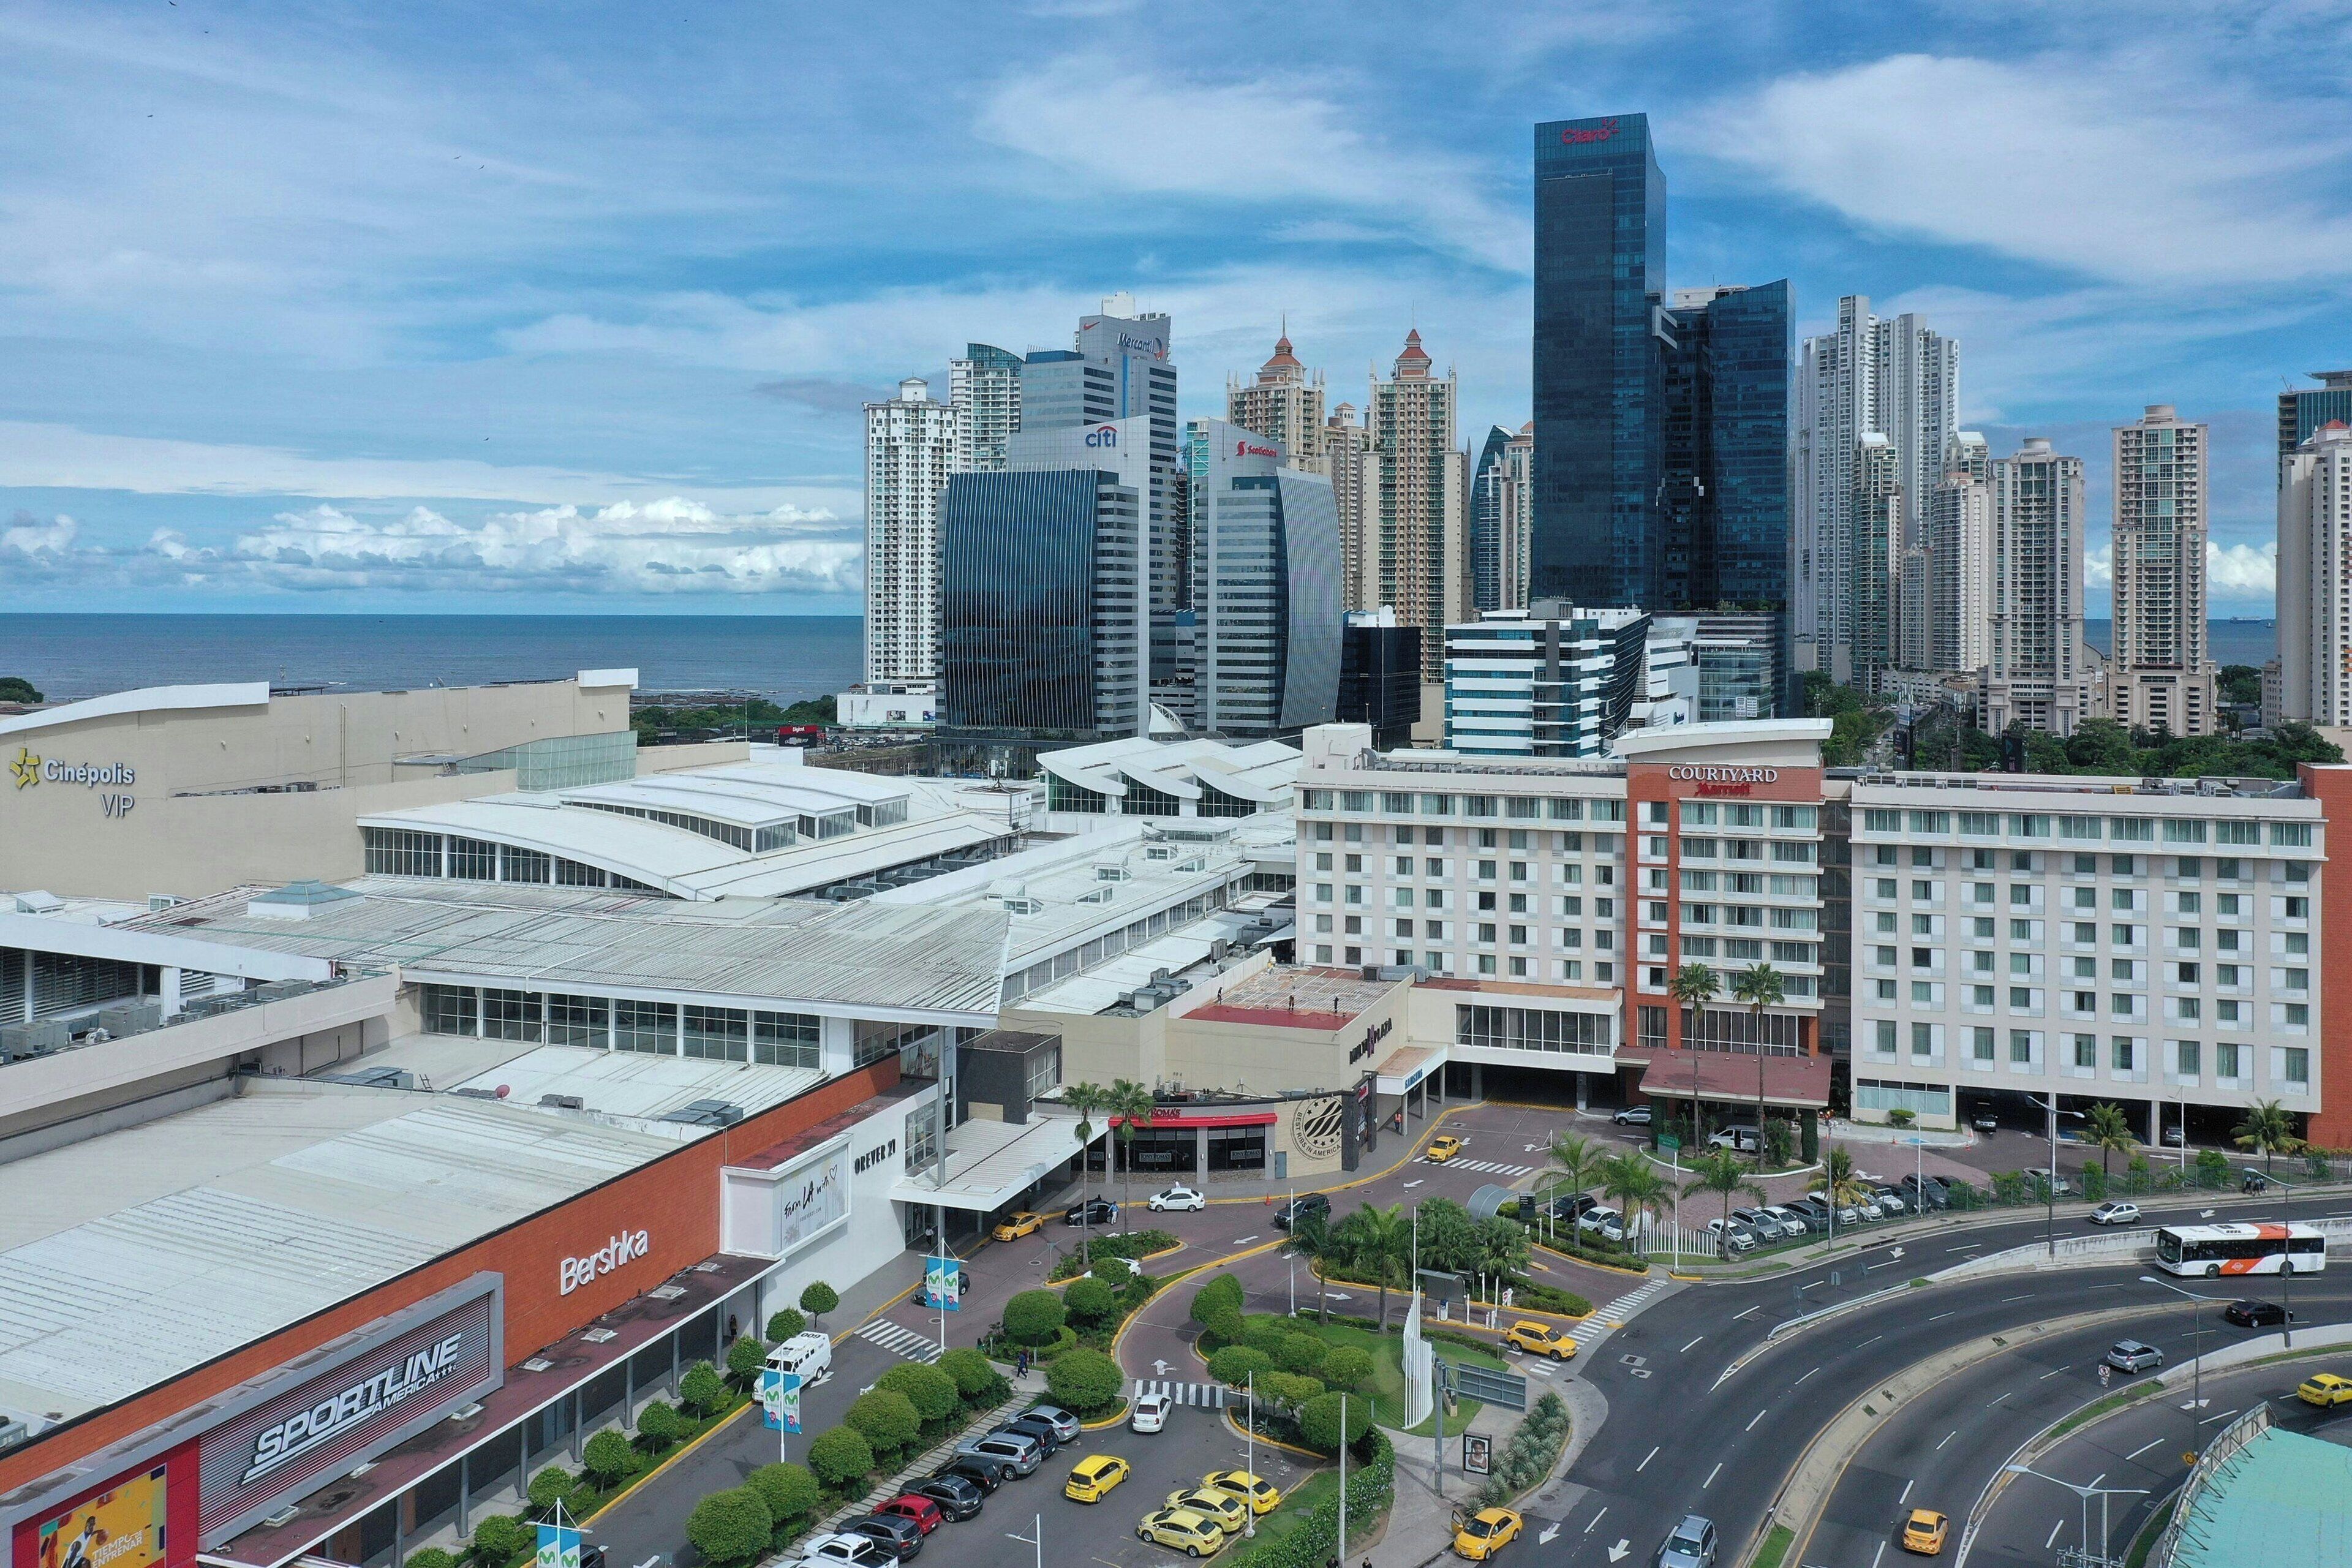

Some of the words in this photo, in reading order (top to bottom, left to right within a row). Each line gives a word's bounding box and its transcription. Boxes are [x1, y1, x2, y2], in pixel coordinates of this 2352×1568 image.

[1562, 127, 1610, 144] Claro
[1117, 333, 1155, 353] Mercantil
[1086, 429, 1116, 447] citi
[1248, 445, 1277, 458] Scotiabank
[43, 759, 135, 788] Cinépolis
[1669, 766, 1777, 783] COURTYARD
[1695, 783, 1752, 797] Marriott
[100, 794, 135, 818] VIP
[887, 1138, 896, 1157] 21
[1297, 1133, 1307, 1148] RIBS
[1306, 1145, 1313, 1154] IN
[1313, 1144, 1341, 1156] AMERICA
[802, 1180, 814, 1210] LA
[560, 1230, 648, 1296] Bershka
[254, 1333, 461, 1464] SPORTLINE
[371, 1372, 435, 1416] AMERICA
[91, 1537, 143, 1568] ENTRENAR
